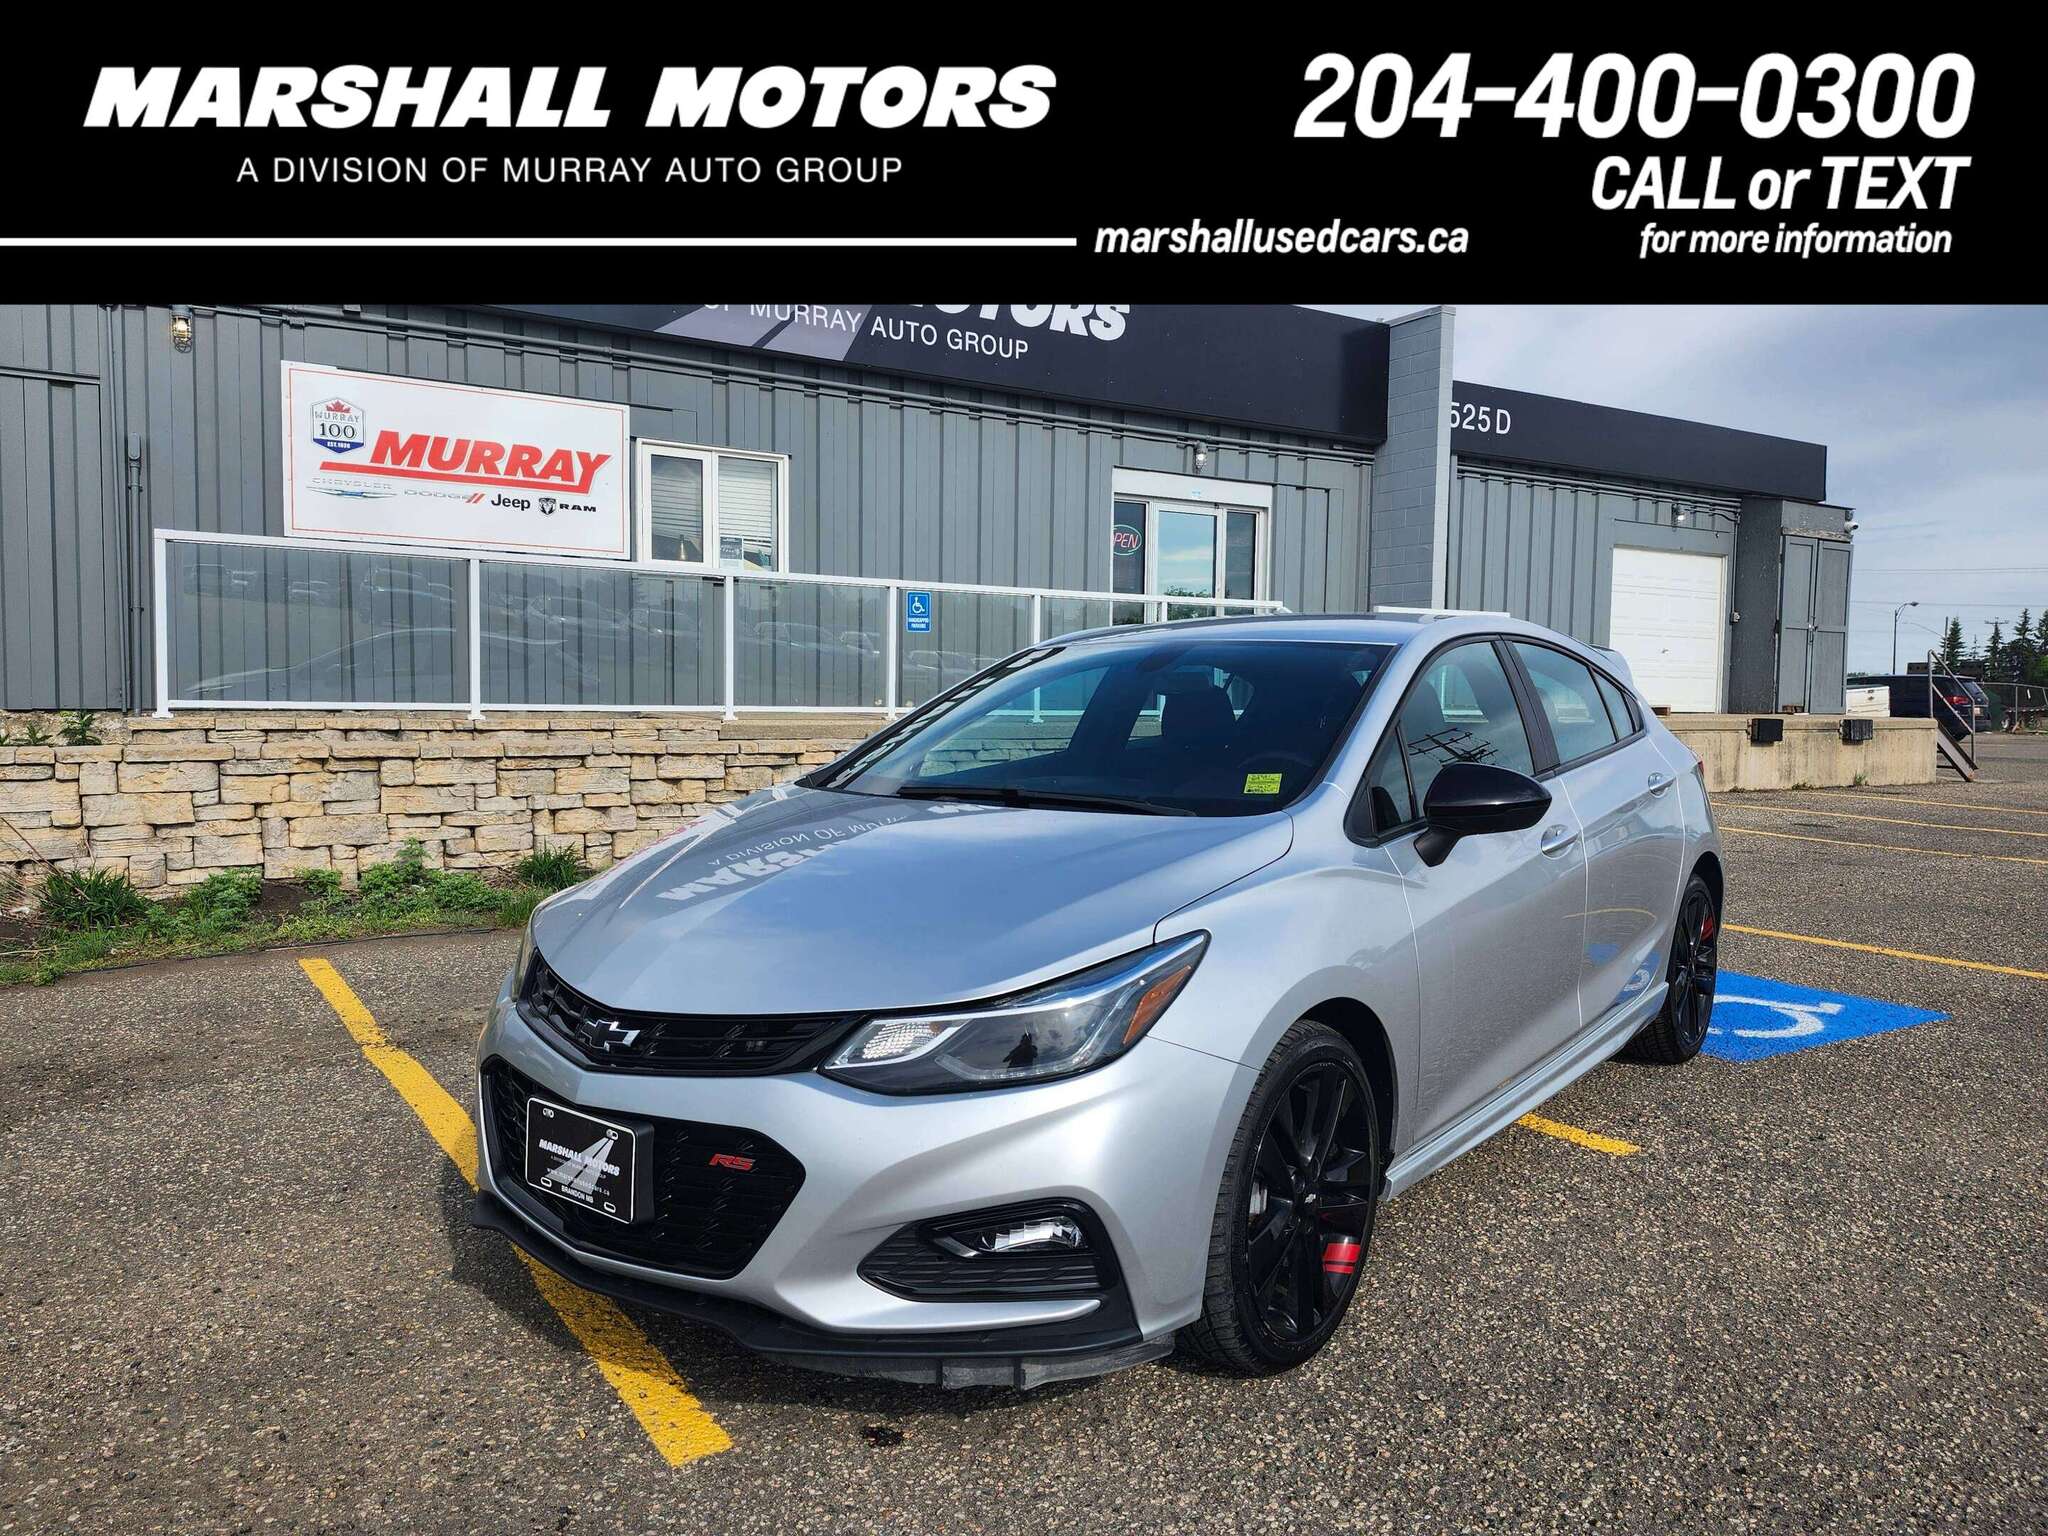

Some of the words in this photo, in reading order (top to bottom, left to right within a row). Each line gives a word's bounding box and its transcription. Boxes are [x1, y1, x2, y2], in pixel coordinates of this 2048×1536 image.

[870, 315, 938, 346] AUTO
[946, 328, 1029, 360] GROUP
[320, 422, 356, 439] 100
[369, 430, 612, 486] MURRAY
[491, 493, 531, 511] Jeep
[559, 503, 597, 512] RAM
[1113, 532, 1139, 549] PEN
[539, 1138, 583, 1163] MARSHALL
[709, 1153, 754, 1170] RS
